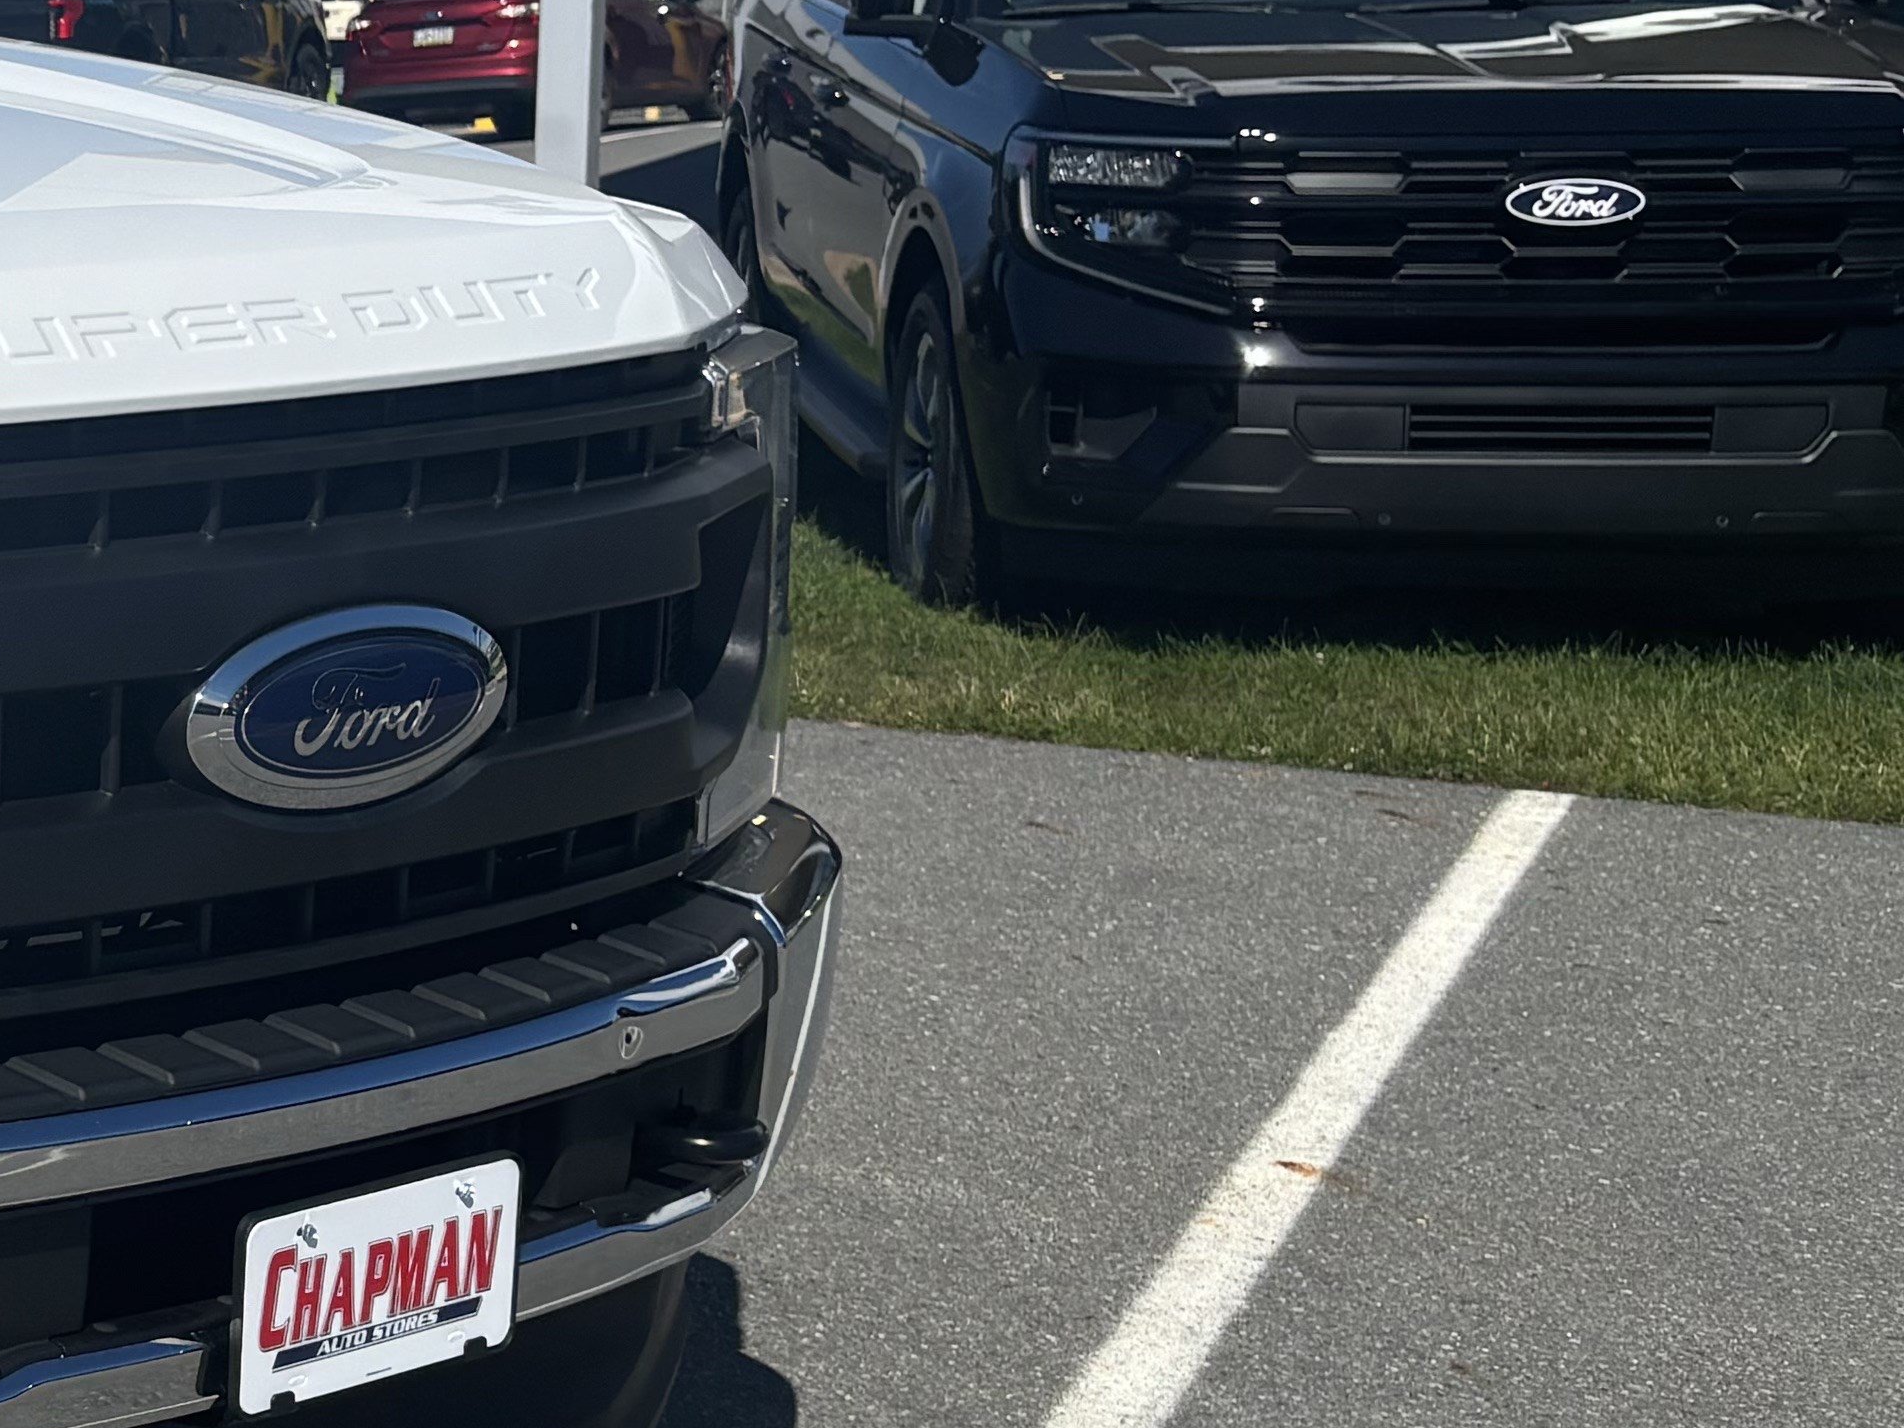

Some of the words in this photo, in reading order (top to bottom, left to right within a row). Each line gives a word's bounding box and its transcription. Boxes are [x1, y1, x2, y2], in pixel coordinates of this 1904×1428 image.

[1531, 184, 1620, 218] Ford
[340, 265, 603, 337] DUTY
[292, 662, 442, 757] Ford
[258, 1205, 504, 1353] CHAPMAN
[316, 1331, 368, 1357] AUTO
[370, 1308, 441, 1341] STORES
